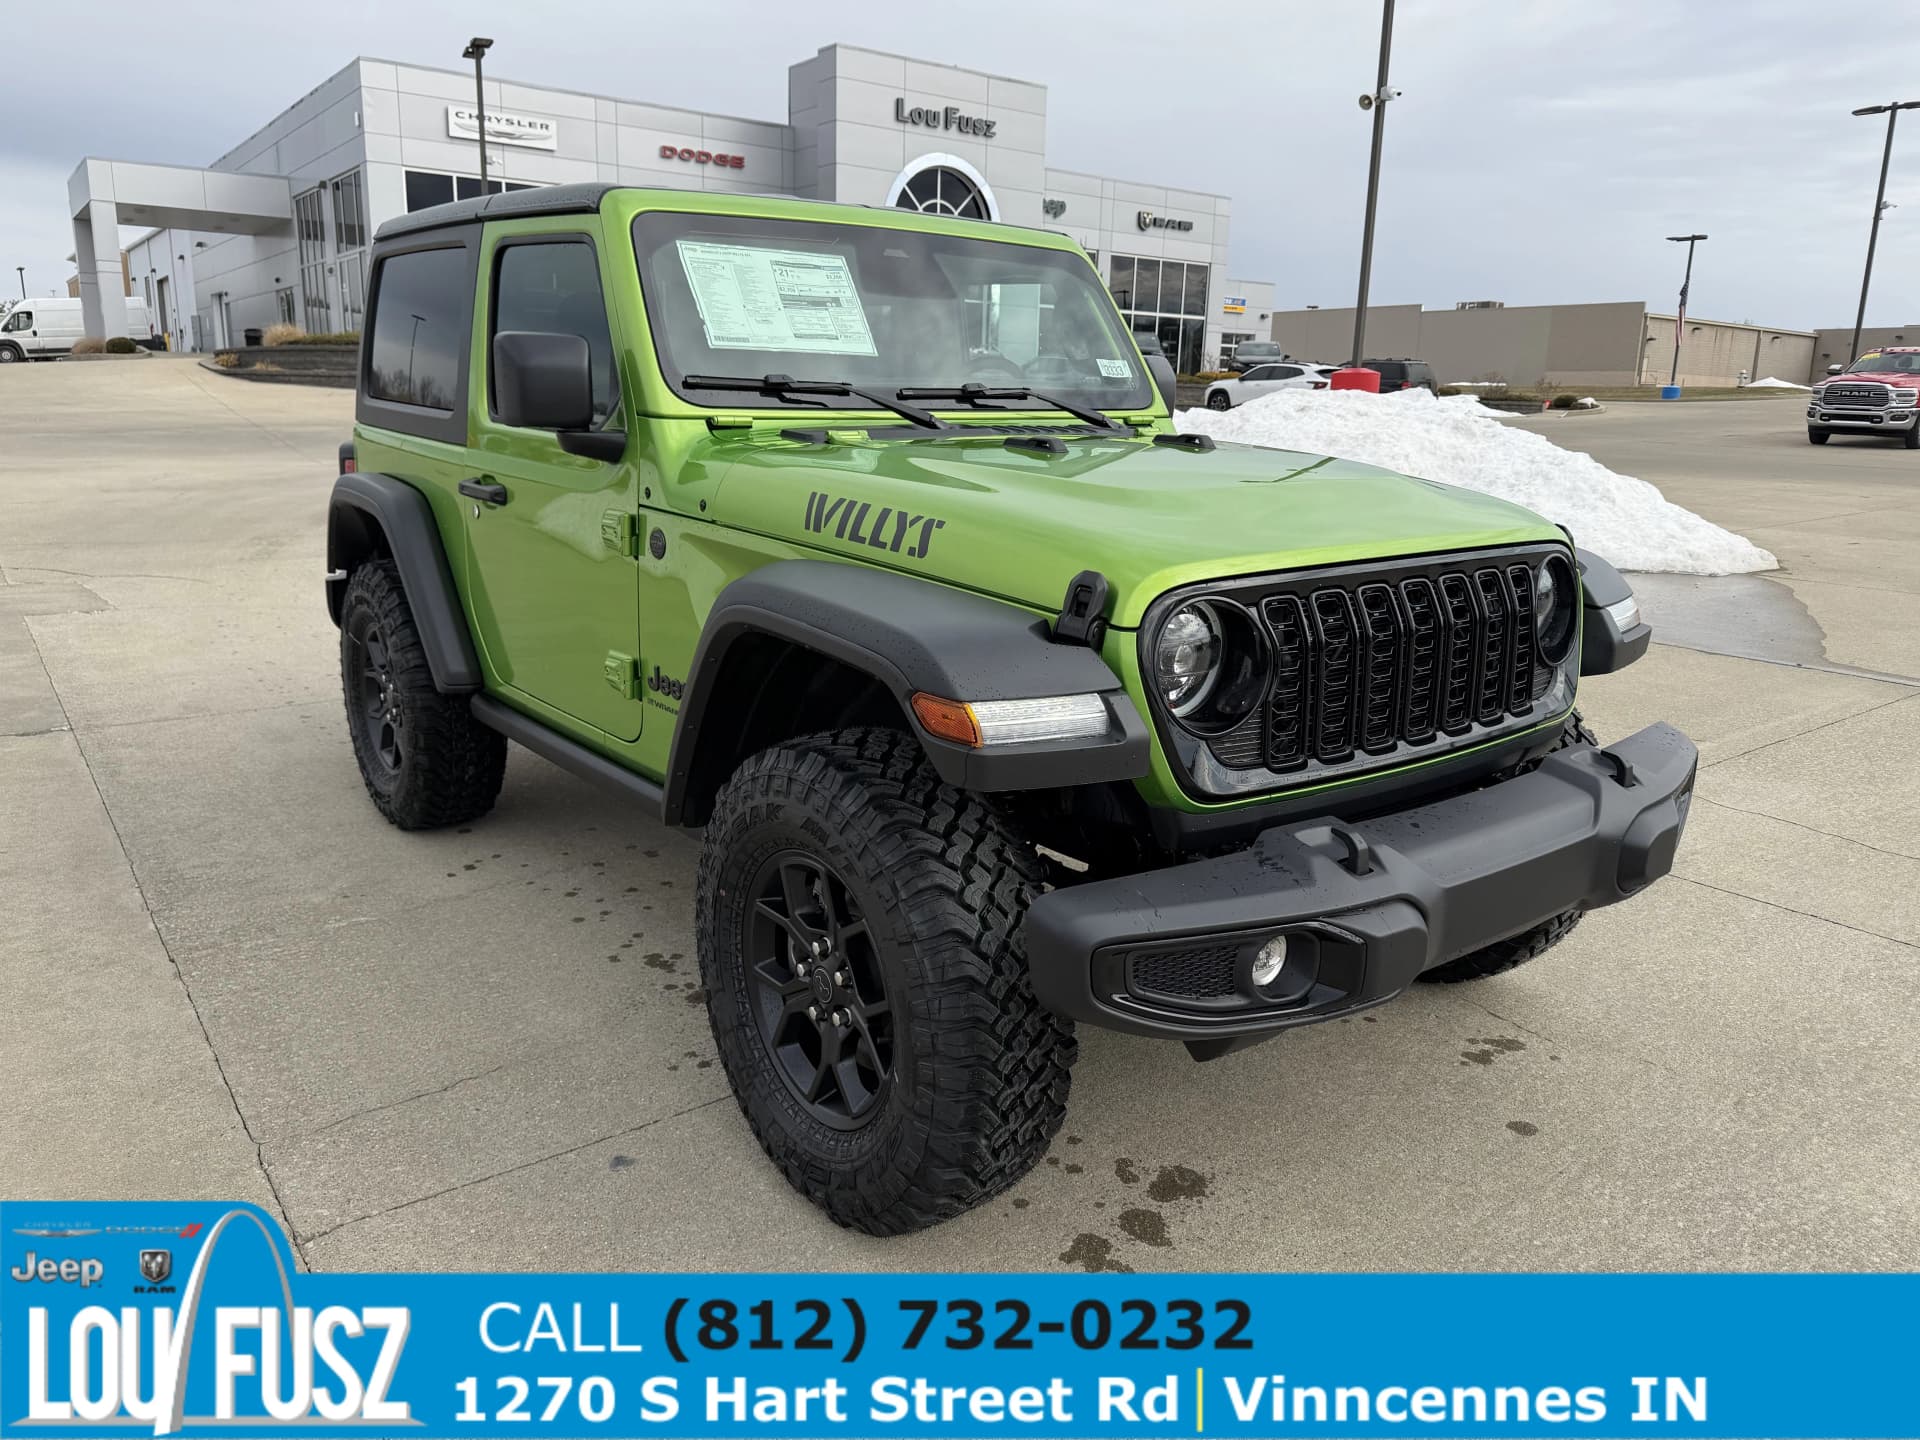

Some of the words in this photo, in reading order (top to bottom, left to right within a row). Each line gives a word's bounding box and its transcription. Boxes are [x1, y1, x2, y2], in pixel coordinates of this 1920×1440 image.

[455, 111, 550, 131] CHRYSLER
[895, 97, 940, 128] Lou
[944, 106, 996, 138] Fusz
[659, 145, 746, 169] DODGE
[1153, 217, 1193, 232] RAM
[804, 491, 946, 559] WILLYS
[648, 664, 688, 701] Jee
